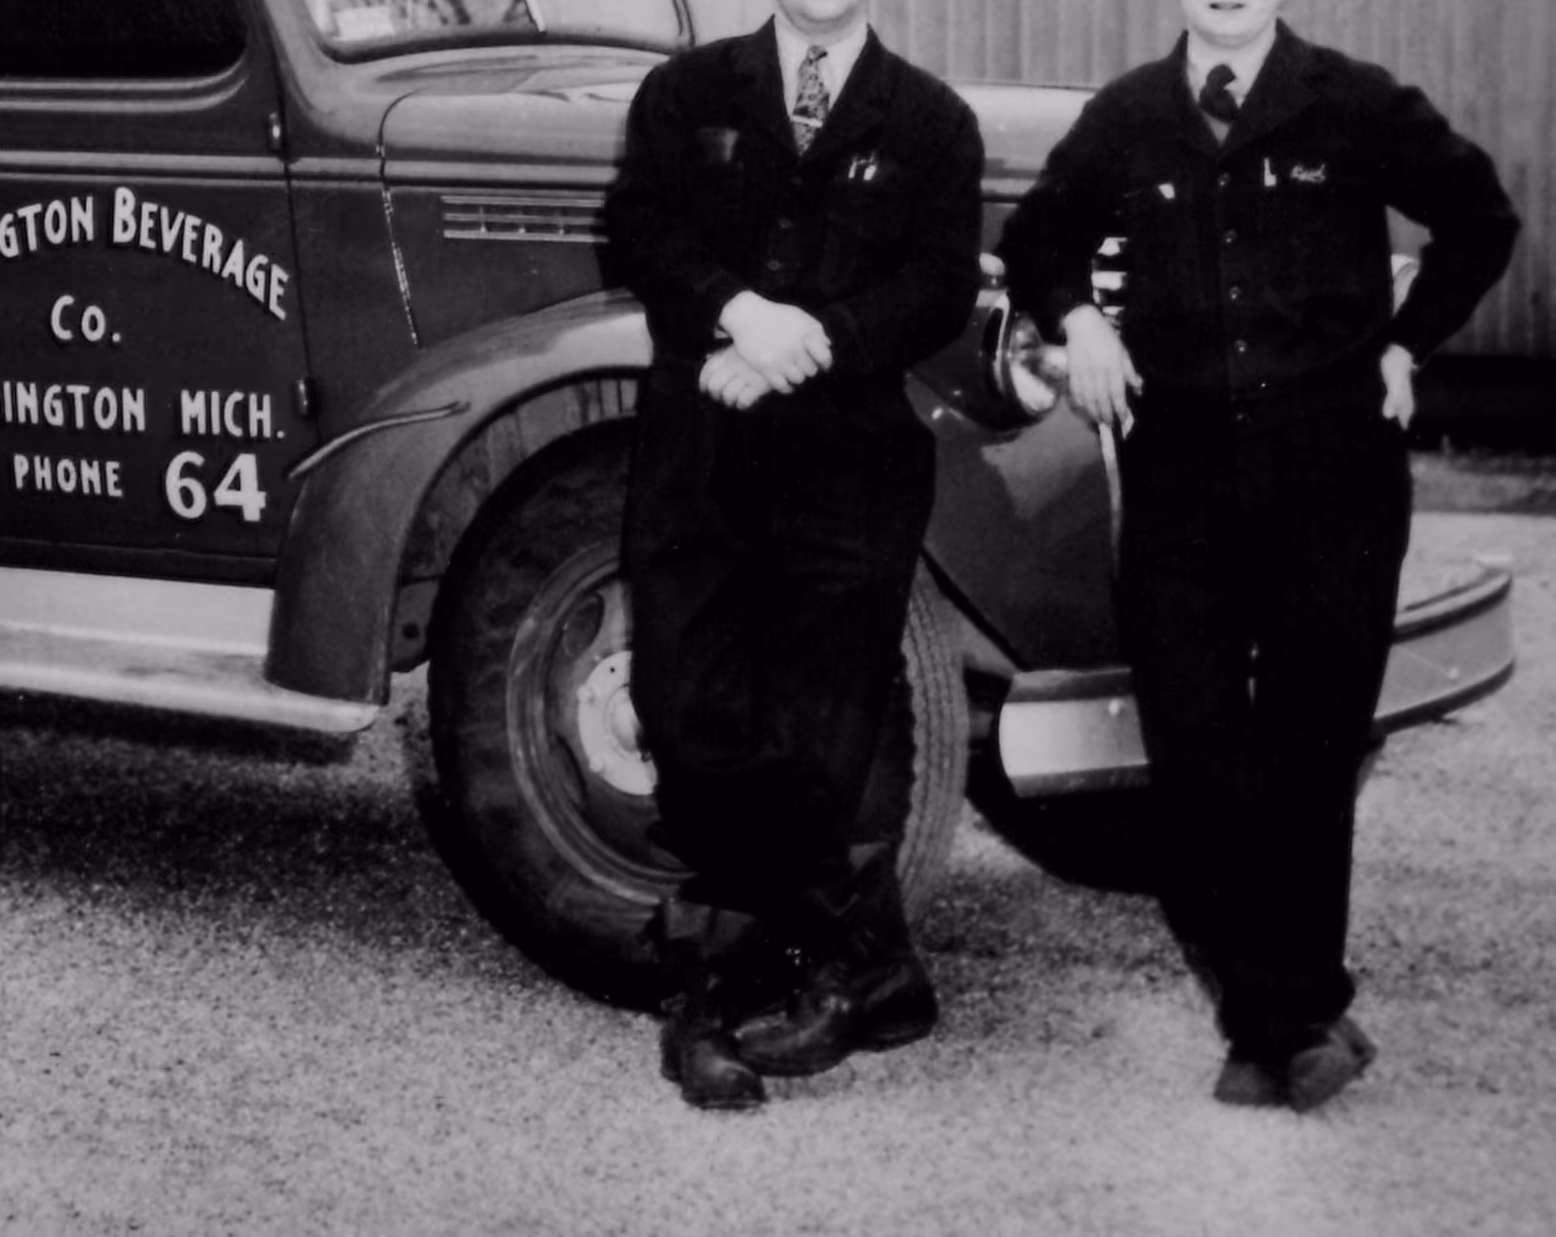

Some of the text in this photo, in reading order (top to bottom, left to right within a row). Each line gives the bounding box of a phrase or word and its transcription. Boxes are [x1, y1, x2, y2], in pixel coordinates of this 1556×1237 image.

[113, 185, 290, 321] BEVERAGE
[180, 389, 286, 439] MICH.
[13, 450, 268, 523] PHONE 64
